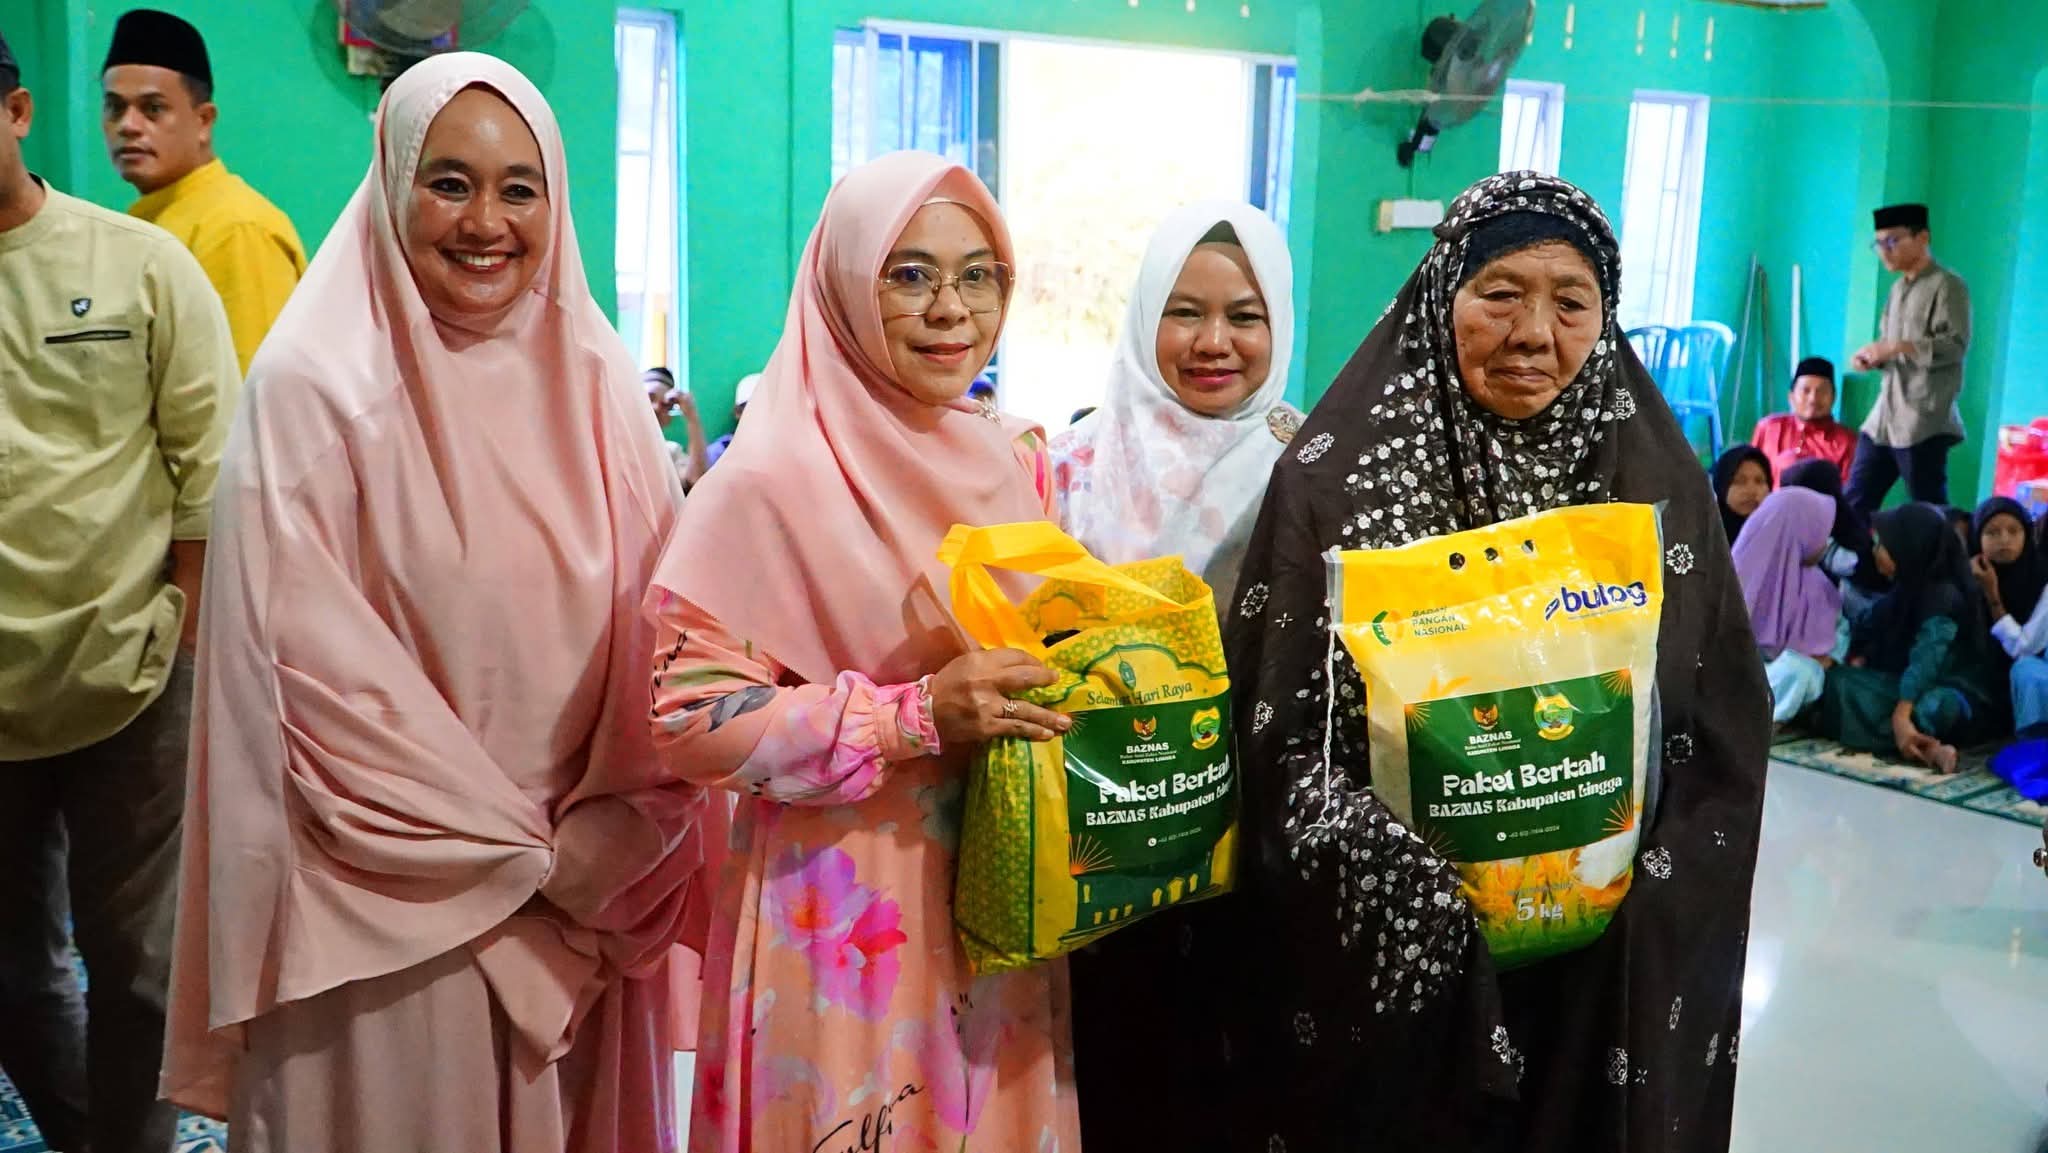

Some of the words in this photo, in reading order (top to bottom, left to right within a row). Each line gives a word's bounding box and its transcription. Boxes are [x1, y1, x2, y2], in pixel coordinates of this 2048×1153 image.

[1561, 581, 1648, 613] bulog
[1412, 614, 1457, 626] PANGAN
[1414, 623, 1467, 637] NASIONAL
[1162, 681, 1193, 699] Raya
[1126, 742, 1170, 754] BAZNAS
[1469, 730, 1513, 745] BAZNAS
[1443, 770, 1515, 797] Paket
[1519, 750, 1606, 788] Berkah
[1100, 779, 1167, 804] Paket
[1429, 800, 1493, 818] BAZNAS
[1496, 788, 1576, 811] Kabupaten
[1578, 776, 1622, 798] Lingga
[1086, 808, 1147, 826] BAZNAS
[1149, 791, 1215, 820] Kabupaten
[1516, 896, 1537, 921] 5
